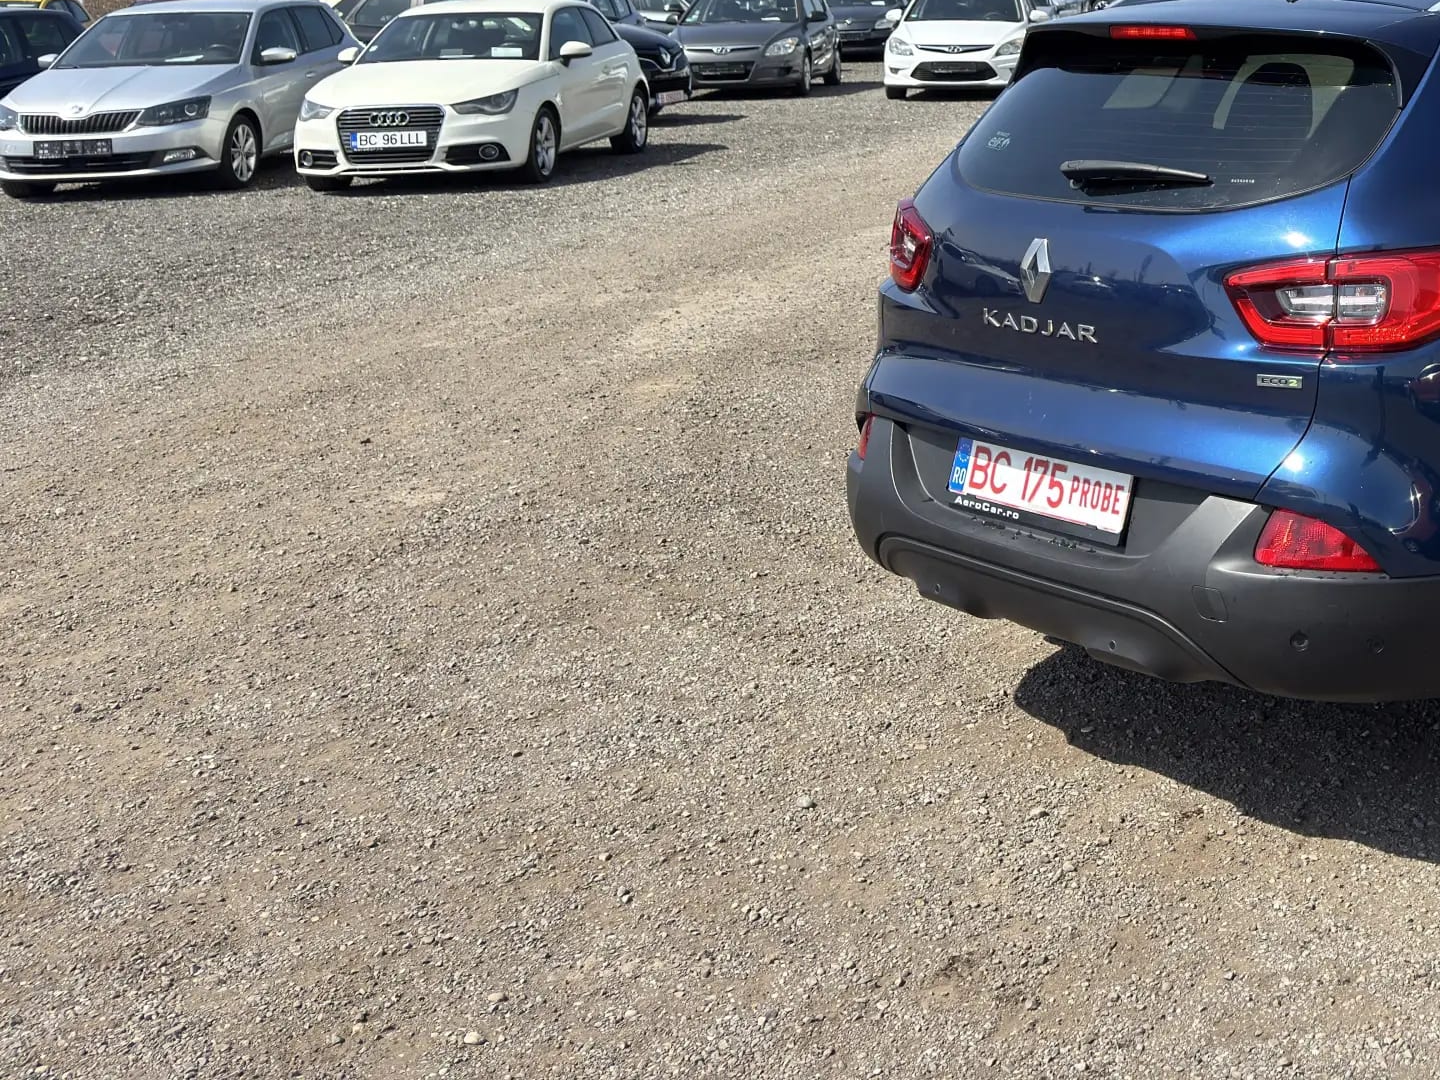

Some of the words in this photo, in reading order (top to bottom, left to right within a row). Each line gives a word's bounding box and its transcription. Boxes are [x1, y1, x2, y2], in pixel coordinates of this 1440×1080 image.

[359, 134, 377, 146] BC
[382, 133, 398, 145] 96
[400, 133, 424, 145] LLL
[982, 307, 1099, 344] KADJAR
[952, 467, 966, 485] RO
[968, 445, 1012, 495] BC
[1021, 455, 1068, 509] 175
[1068, 474, 1125, 516] PROBE
[953, 495, 1020, 521] AeroCar.ro
